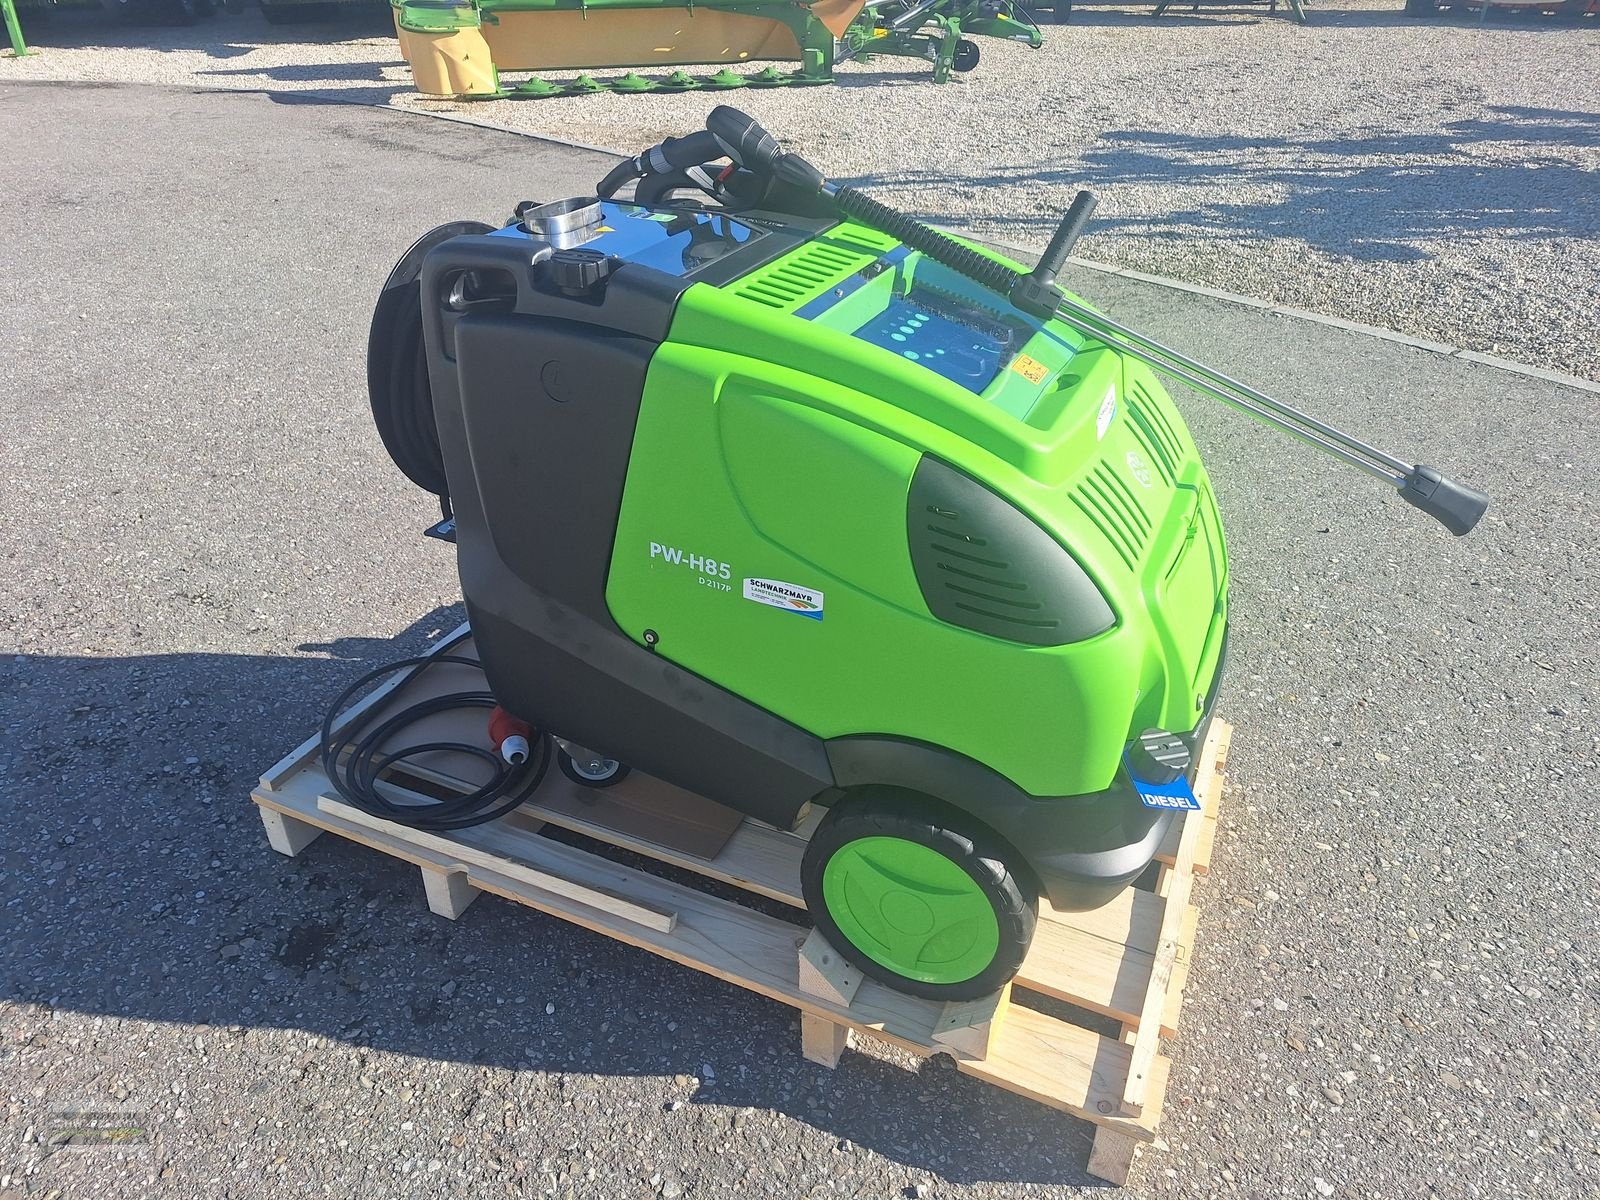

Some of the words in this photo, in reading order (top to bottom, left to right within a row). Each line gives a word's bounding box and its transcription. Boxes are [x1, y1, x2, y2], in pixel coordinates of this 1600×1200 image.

[650, 541, 731, 580] PW-H85
[750, 579, 813, 602] SCHWARZMAYR
[1144, 793, 1197, 808] DIESEL
